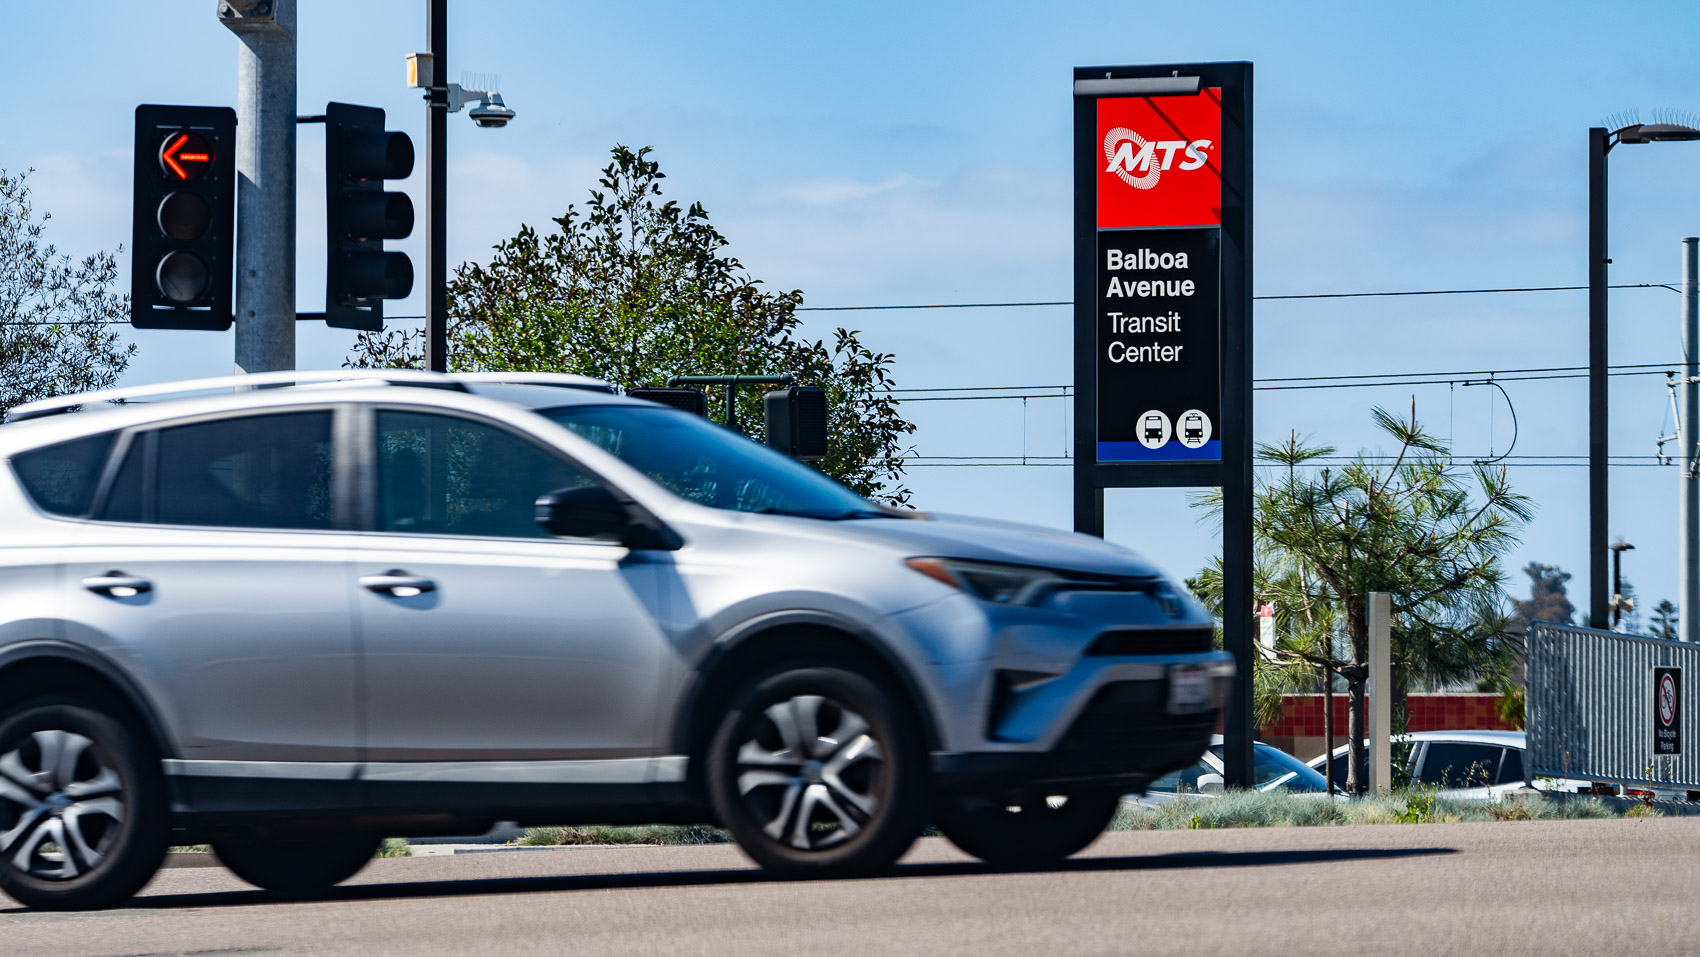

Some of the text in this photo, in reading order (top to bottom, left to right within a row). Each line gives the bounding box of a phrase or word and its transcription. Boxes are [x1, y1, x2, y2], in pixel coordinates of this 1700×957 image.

[1105, 139, 1213, 172] MTS
[1107, 248, 1189, 270] Balboa
[1106, 276, 1195, 298] Avenue
[1107, 311, 1181, 333] Transit
[1108, 341, 1183, 363] Center
[1658, 729, 1676, 740] No Bicycle
[1660, 741, 1674, 752] Parking
